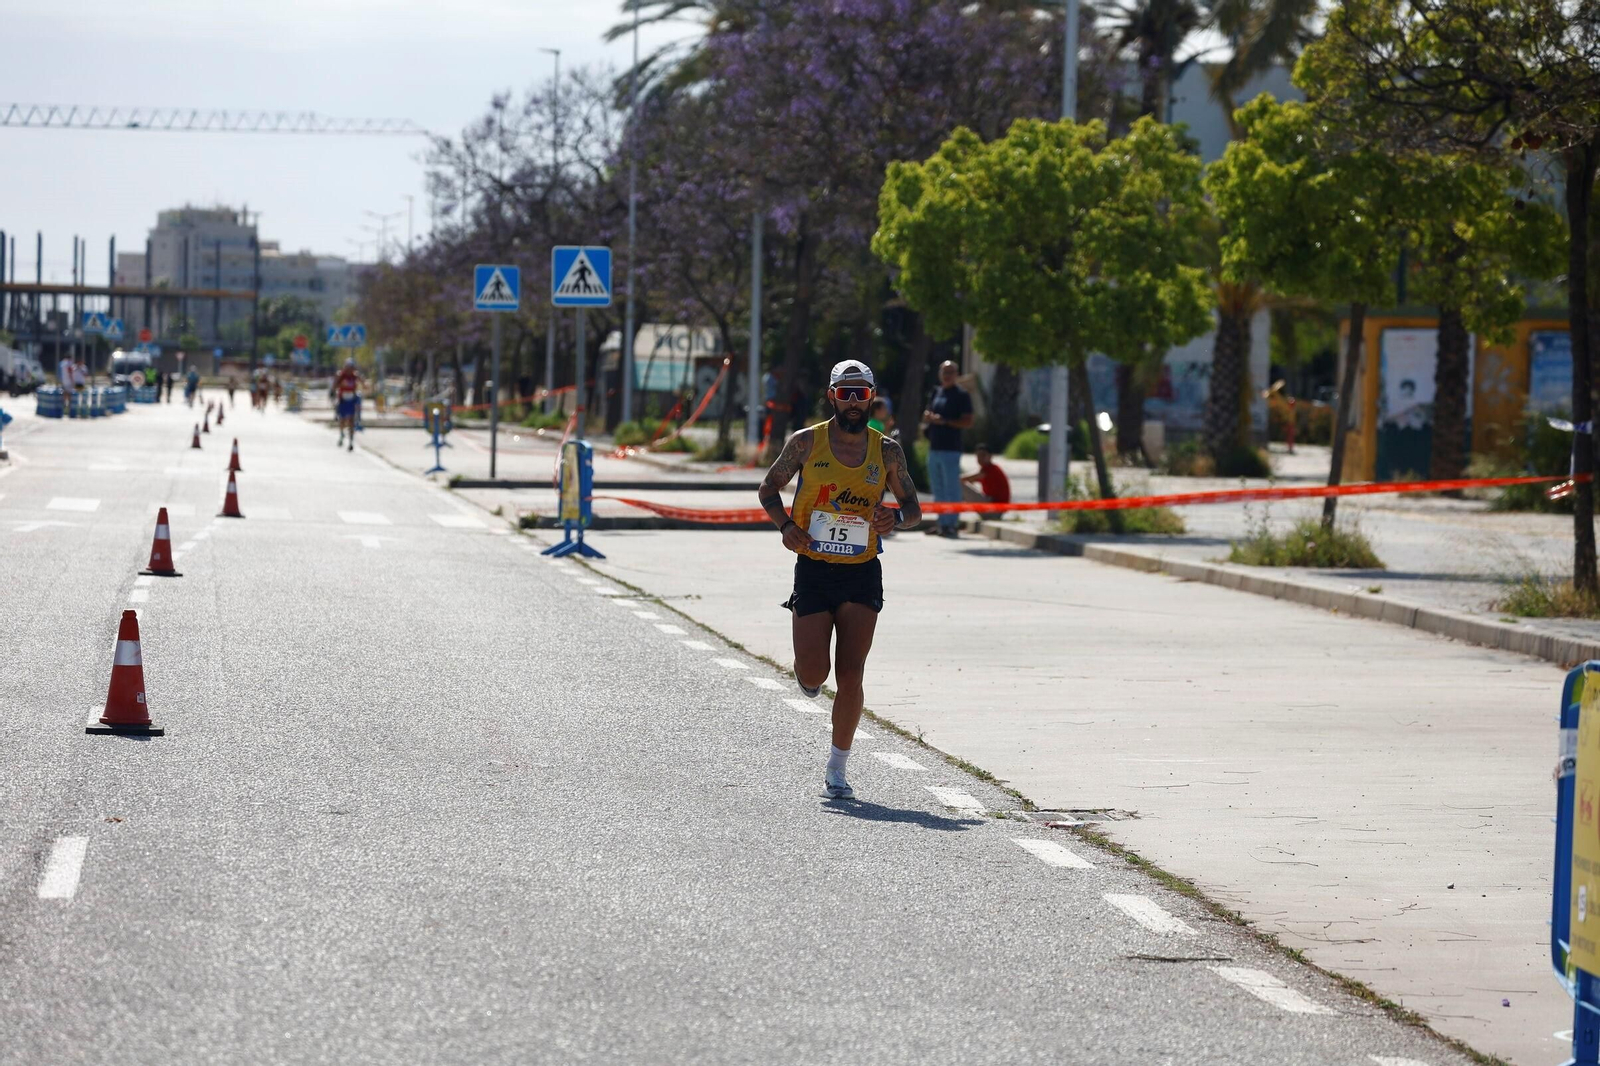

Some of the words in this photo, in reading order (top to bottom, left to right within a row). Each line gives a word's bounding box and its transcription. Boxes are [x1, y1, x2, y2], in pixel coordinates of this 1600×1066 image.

[814, 460, 829, 468] vive
[835, 487, 870, 507] Álora
[829, 527, 849, 542] 15
